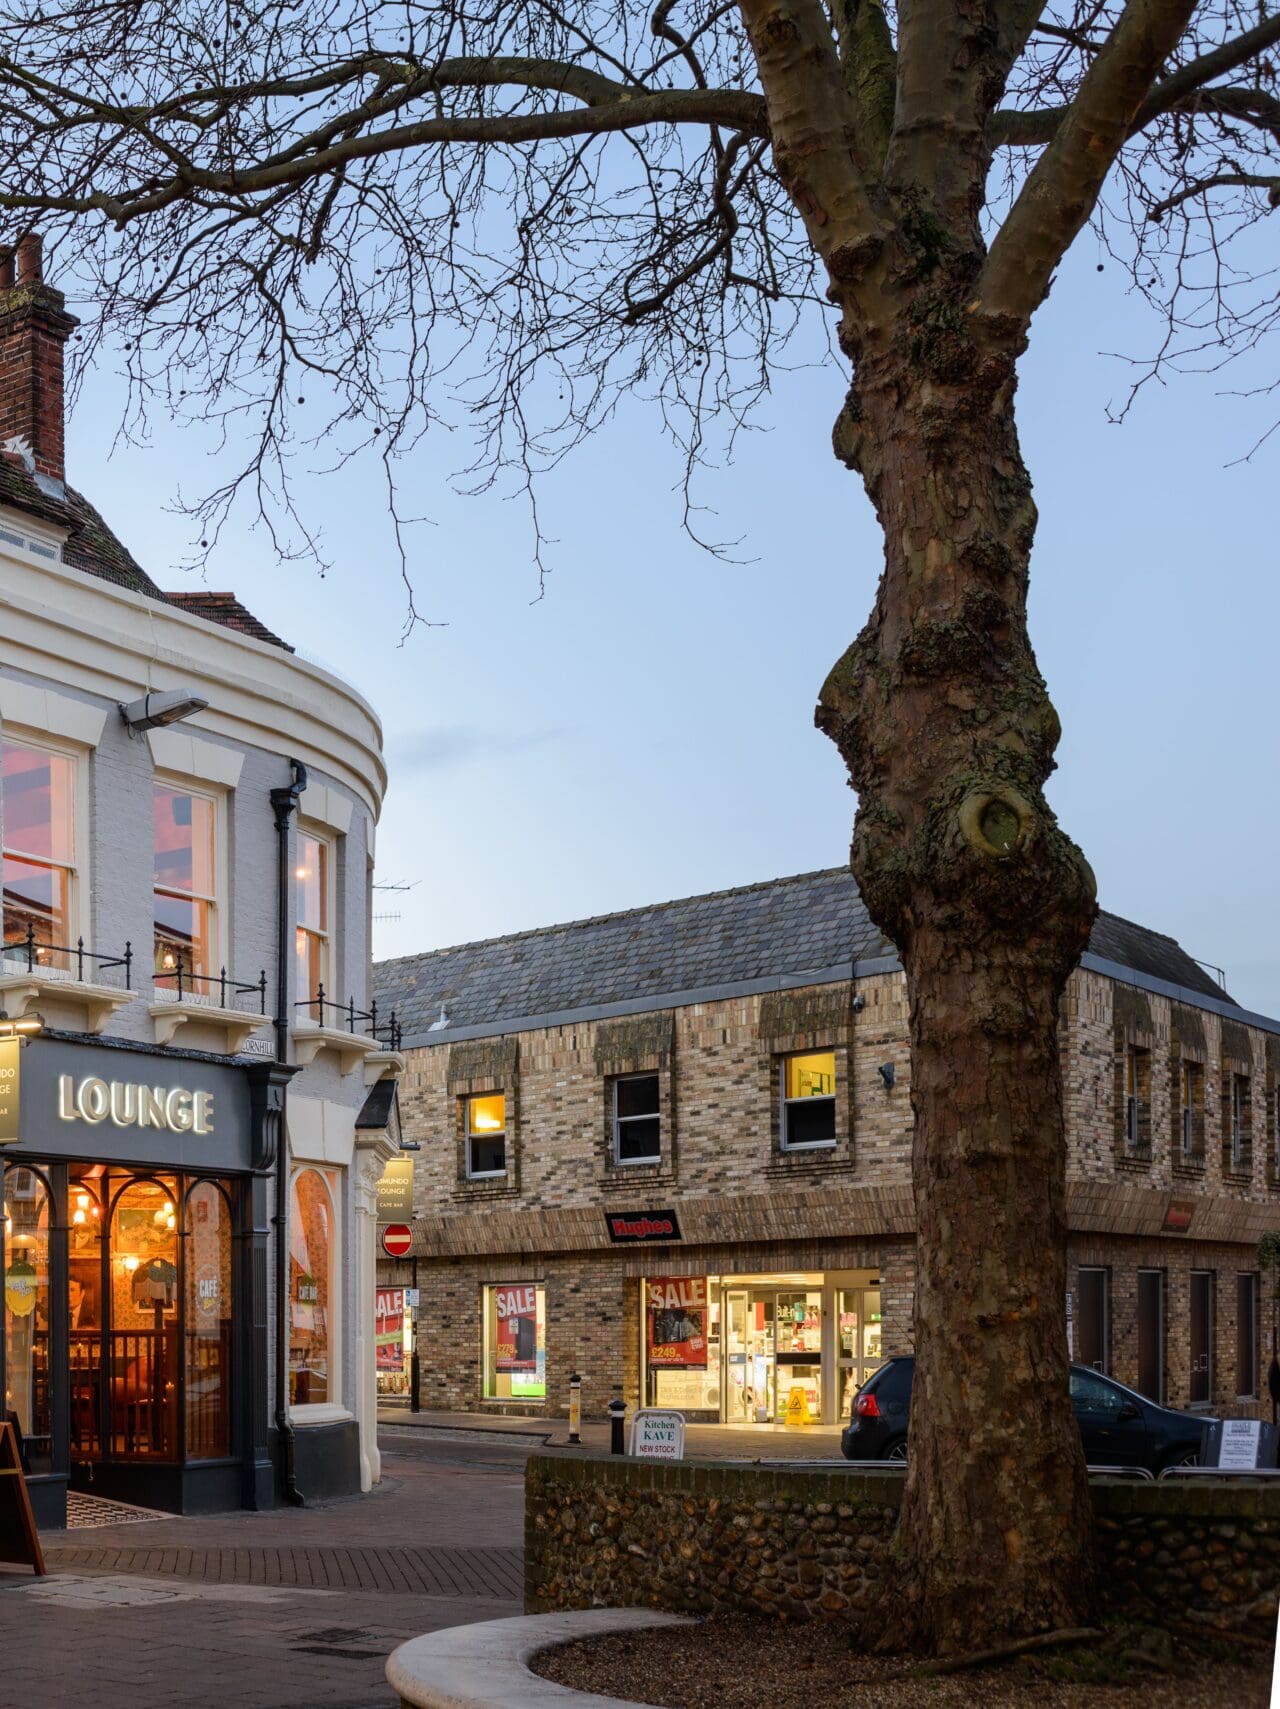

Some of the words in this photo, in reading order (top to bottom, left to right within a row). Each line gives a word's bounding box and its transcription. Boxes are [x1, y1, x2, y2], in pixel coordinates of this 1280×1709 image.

[58, 1074, 214, 1133] LOUNGE
[611, 1217, 673, 1238] Hughes
[376, 1290, 403, 1318] ALE
[497, 1287, 536, 1318] SALE
[651, 1279, 706, 1310] SALE
[644, 1420, 675, 1429] Kitchen
[644, 1431, 675, 1441] KAVE
[639, 1444, 653, 1453] NEW
[655, 1445, 675, 1453] STOCK
